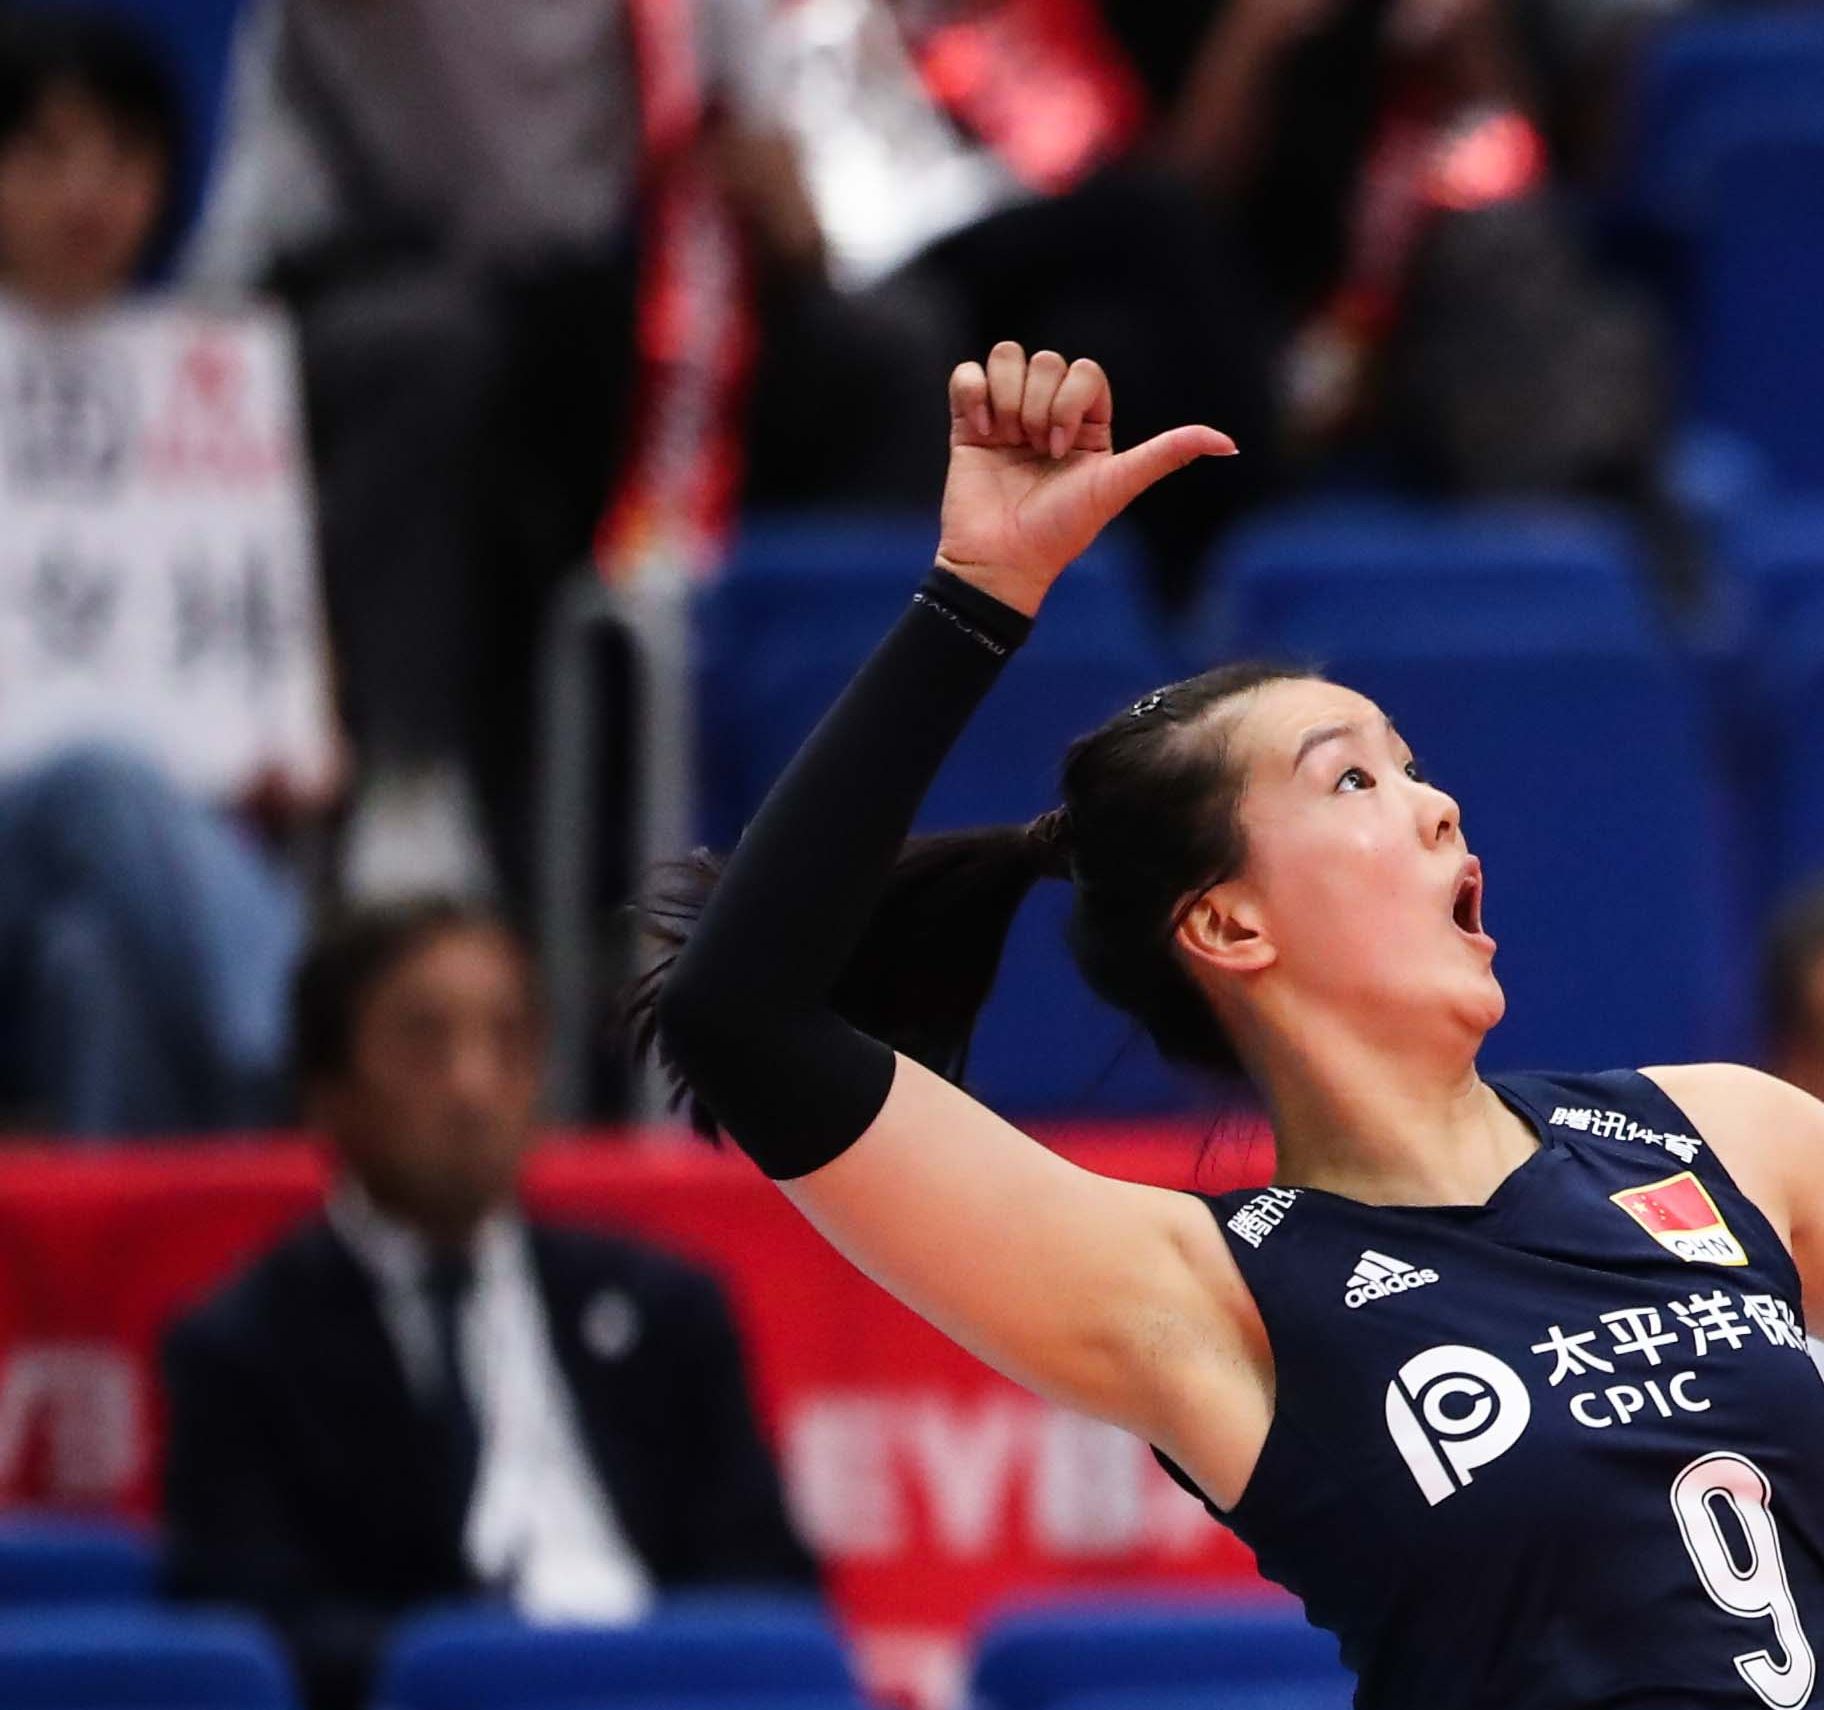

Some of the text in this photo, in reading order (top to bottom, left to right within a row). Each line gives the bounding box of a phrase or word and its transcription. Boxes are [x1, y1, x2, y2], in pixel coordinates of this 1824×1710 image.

[1674, 1237, 1734, 1257] CHN
[1344, 1268, 1440, 1309] adidas
[1530, 1289, 1808, 1387] 太平洋保
[1568, 1370, 1711, 1429] CPIC
